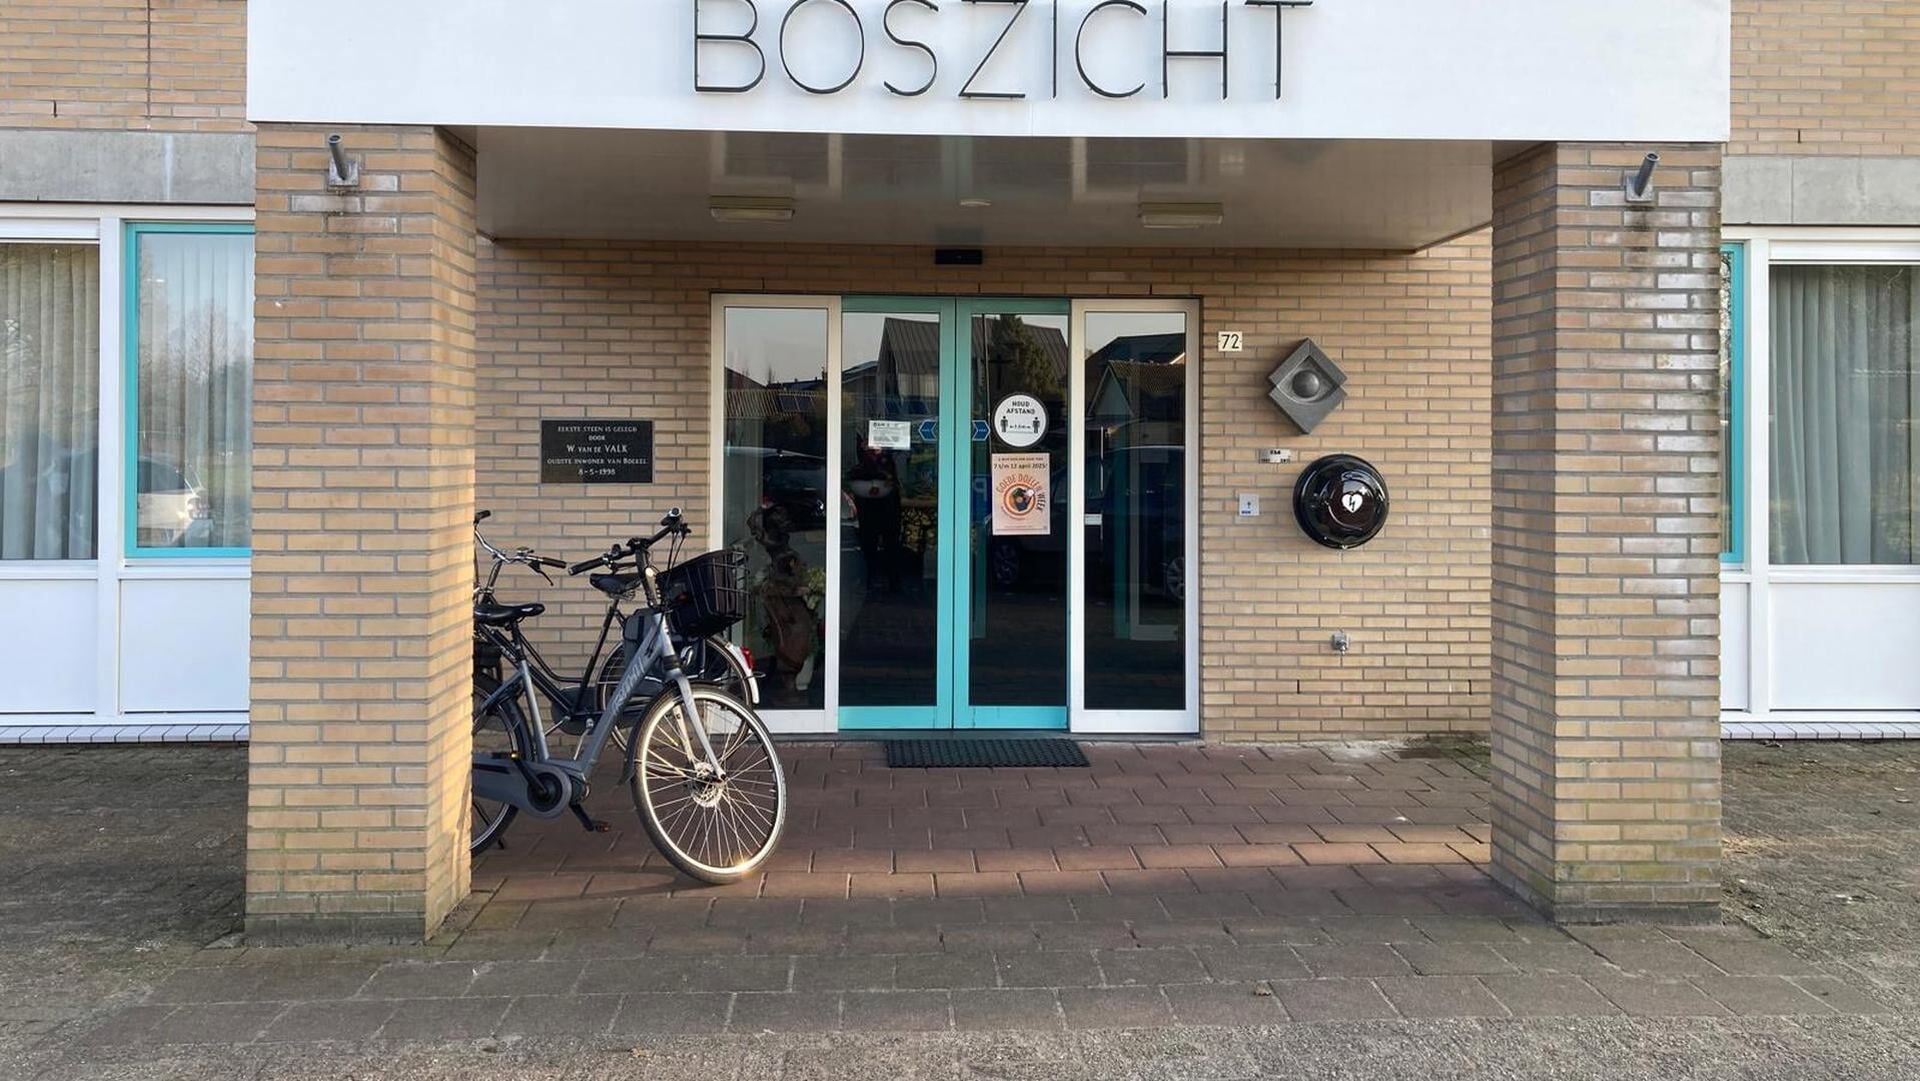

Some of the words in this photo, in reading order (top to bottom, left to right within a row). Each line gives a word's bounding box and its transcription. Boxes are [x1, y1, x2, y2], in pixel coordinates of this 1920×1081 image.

[693, 0, 1314, 99] BOSZICHT
[1220, 333, 1240, 350] 72
[604, 444, 628, 453] VALK
